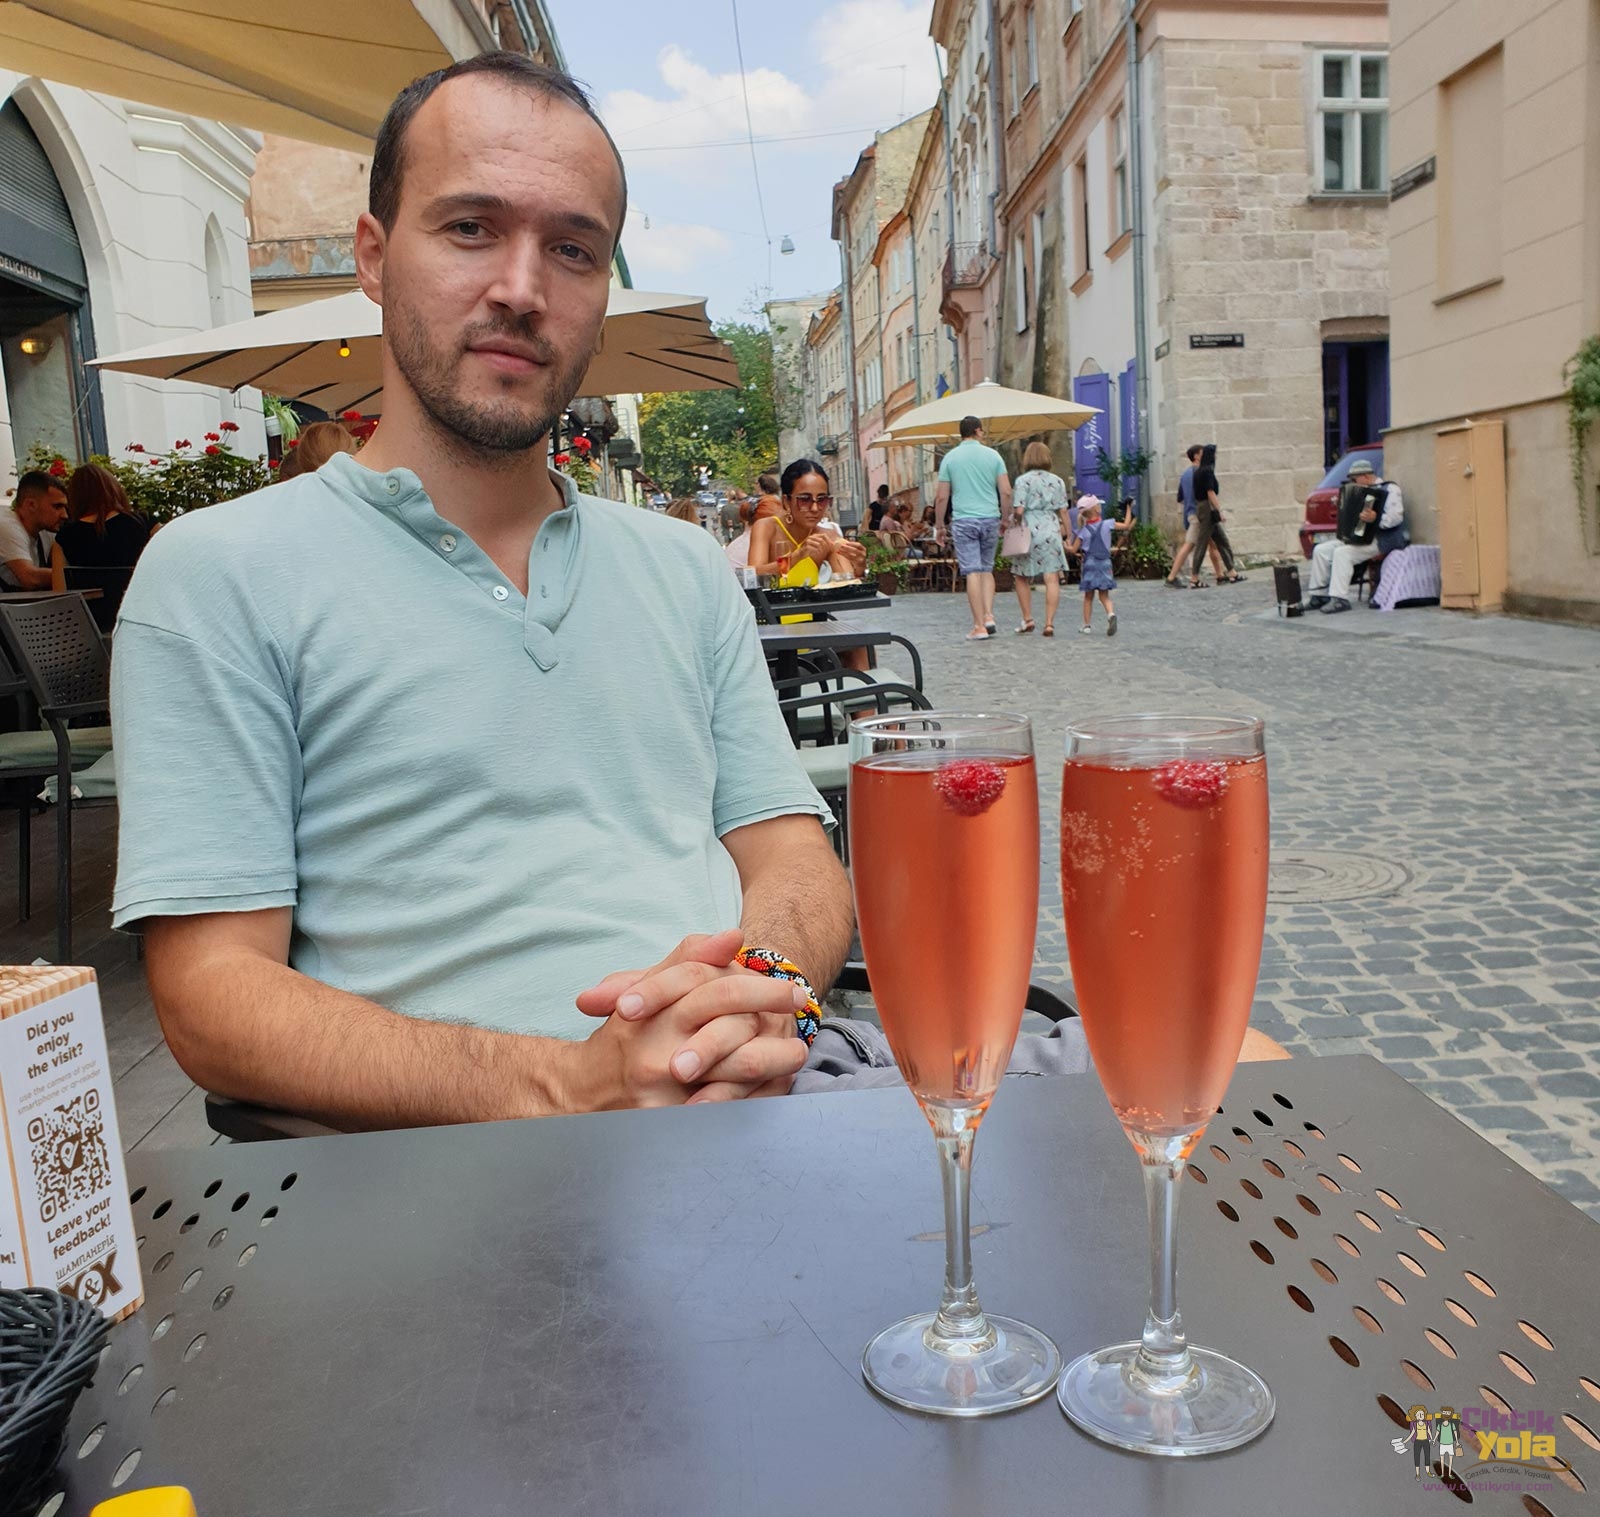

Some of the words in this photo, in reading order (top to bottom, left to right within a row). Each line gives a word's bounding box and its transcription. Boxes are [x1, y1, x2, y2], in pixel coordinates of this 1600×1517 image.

[26, 1020, 49, 1041] Did
[51, 1012, 74, 1032] you
[36, 1032, 70, 1055] enjoy
[27, 1062, 49, 1080] the
[51, 1042, 83, 1067] visit?
[33, 1086, 45, 1096] the
[46, 1073, 72, 1089] camera
[73, 1066, 81, 1076] of
[17, 1090, 60, 1115] smartphone
[47, 1215, 82, 1244] Leave
[85, 1197, 111, 1222] your
[53, 1213, 111, 1260] feedback!
